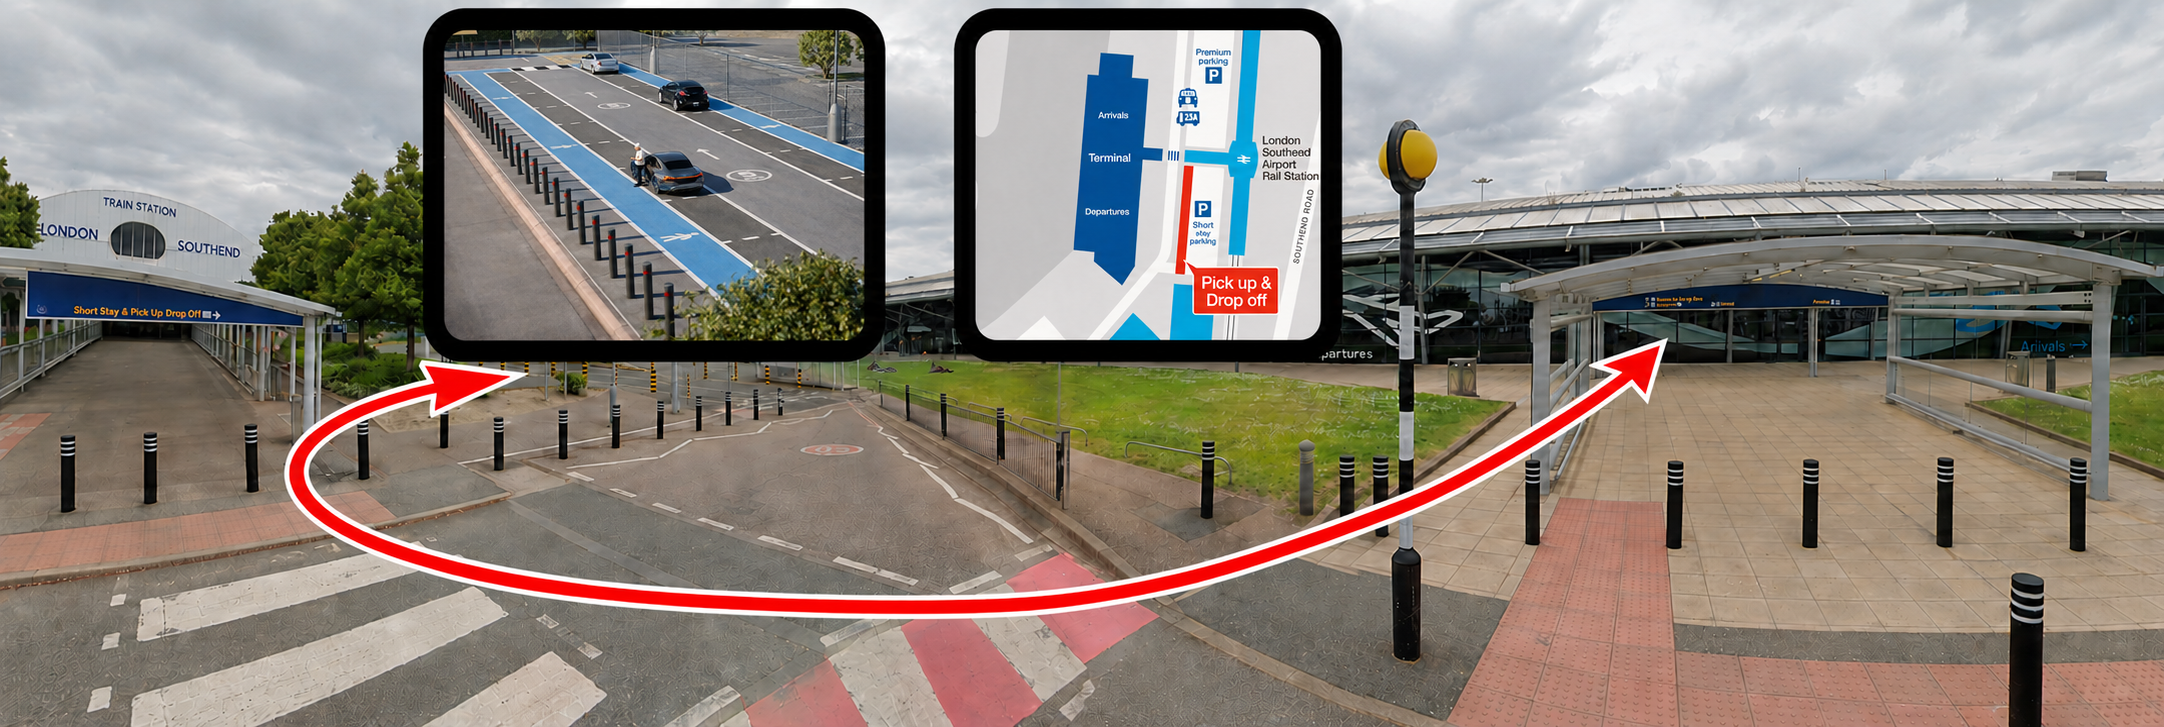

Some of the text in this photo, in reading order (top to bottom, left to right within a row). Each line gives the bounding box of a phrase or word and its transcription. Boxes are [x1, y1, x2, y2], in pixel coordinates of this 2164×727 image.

[103, 197, 177, 218] TRAIN STATION
[40, 223, 99, 241] LONDON
[177, 240, 241, 259] SOUTHEND
[73, 305, 98, 316] Short
[99, 306, 119, 319] Stay
[130, 308, 149, 318] Pick
[150, 309, 164, 319] Up
[165, 309, 187, 321] Drop
[187, 310, 201, 319] Off
[1321, 349, 1373, 361] partures
